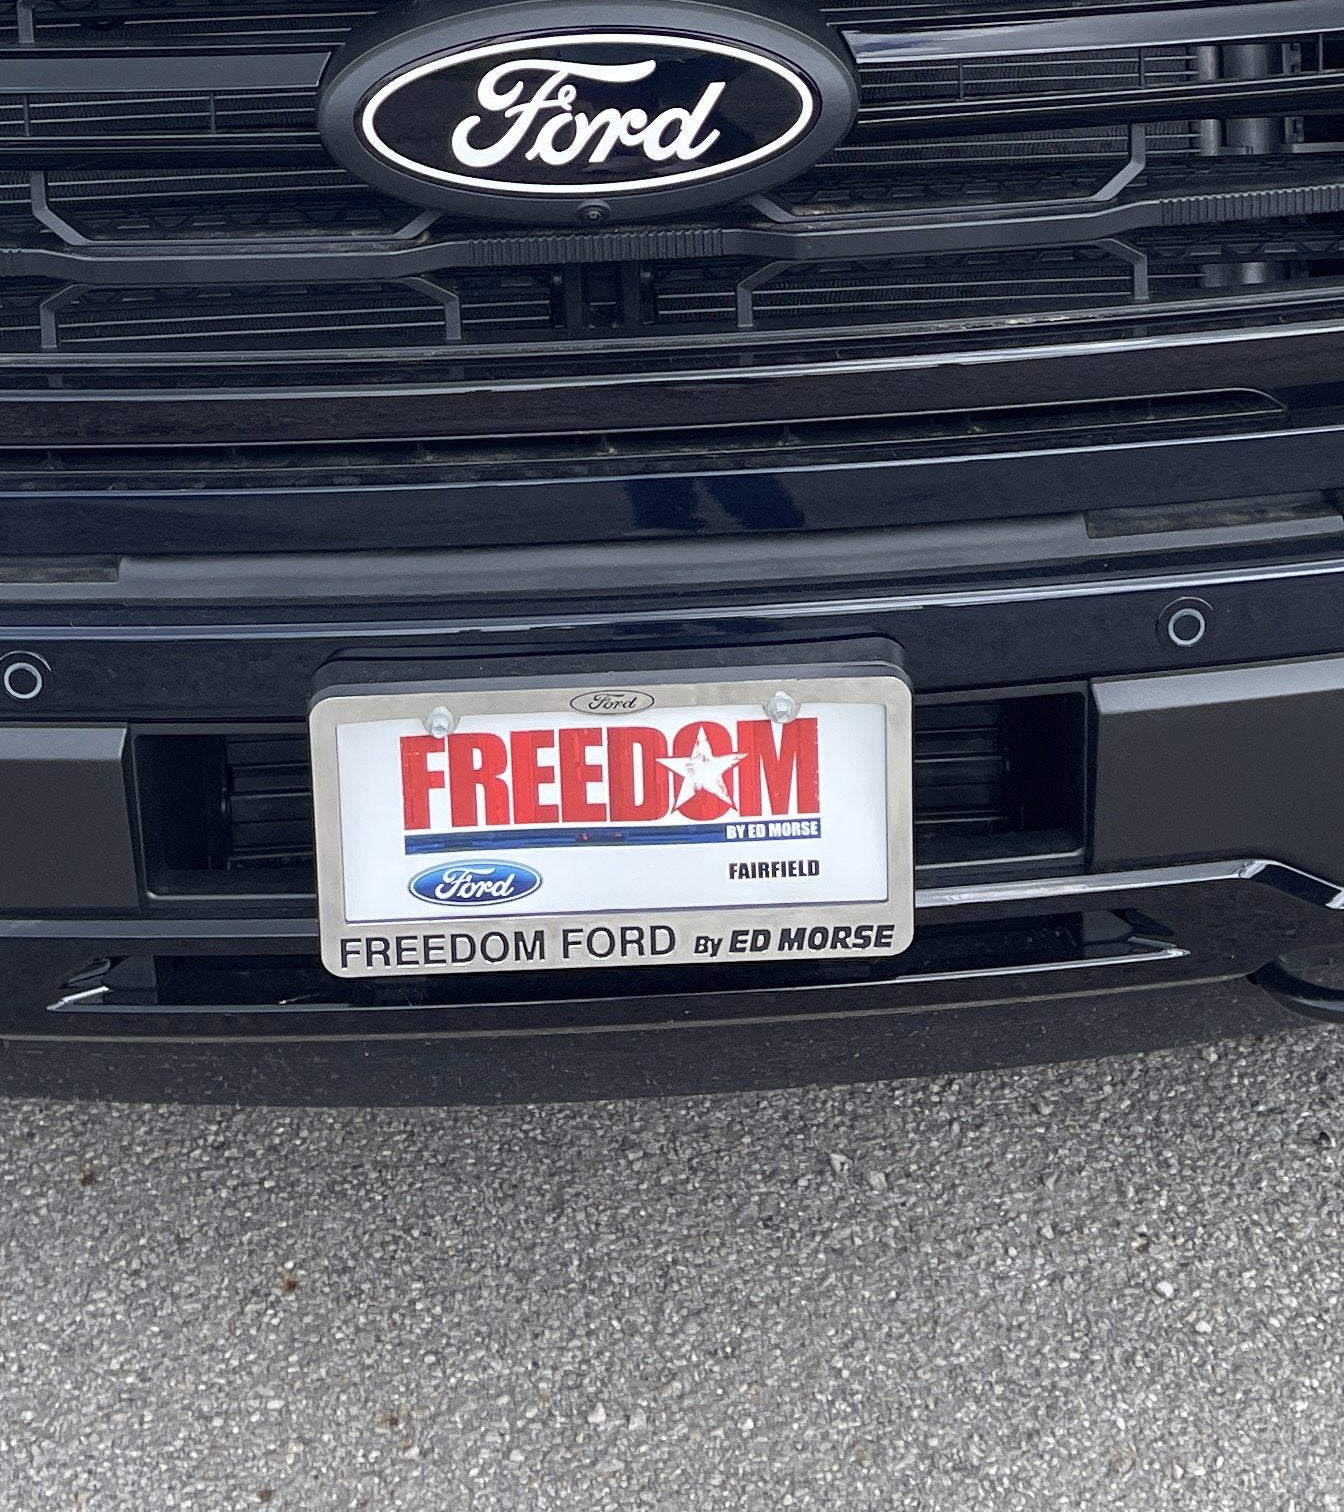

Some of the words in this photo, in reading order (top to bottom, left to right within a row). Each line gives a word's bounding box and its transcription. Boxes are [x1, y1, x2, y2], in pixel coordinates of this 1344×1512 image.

[452, 59, 726, 168] Ford
[588, 694, 637, 710] Ford
[400, 718, 821, 830] FREEDOM
[726, 825, 745, 839] BY
[748, 823, 766, 838] ED
[768, 821, 818, 837] MORSE
[434, 868, 515, 899] Ford
[729, 859, 820, 879] FAIRFIELD
[340, 930, 546, 969] FREEDOM
[562, 925, 676, 959] FORD
[693, 935, 723, 957] By
[729, 929, 771, 953] ED
[778, 924, 895, 951] MORSE
